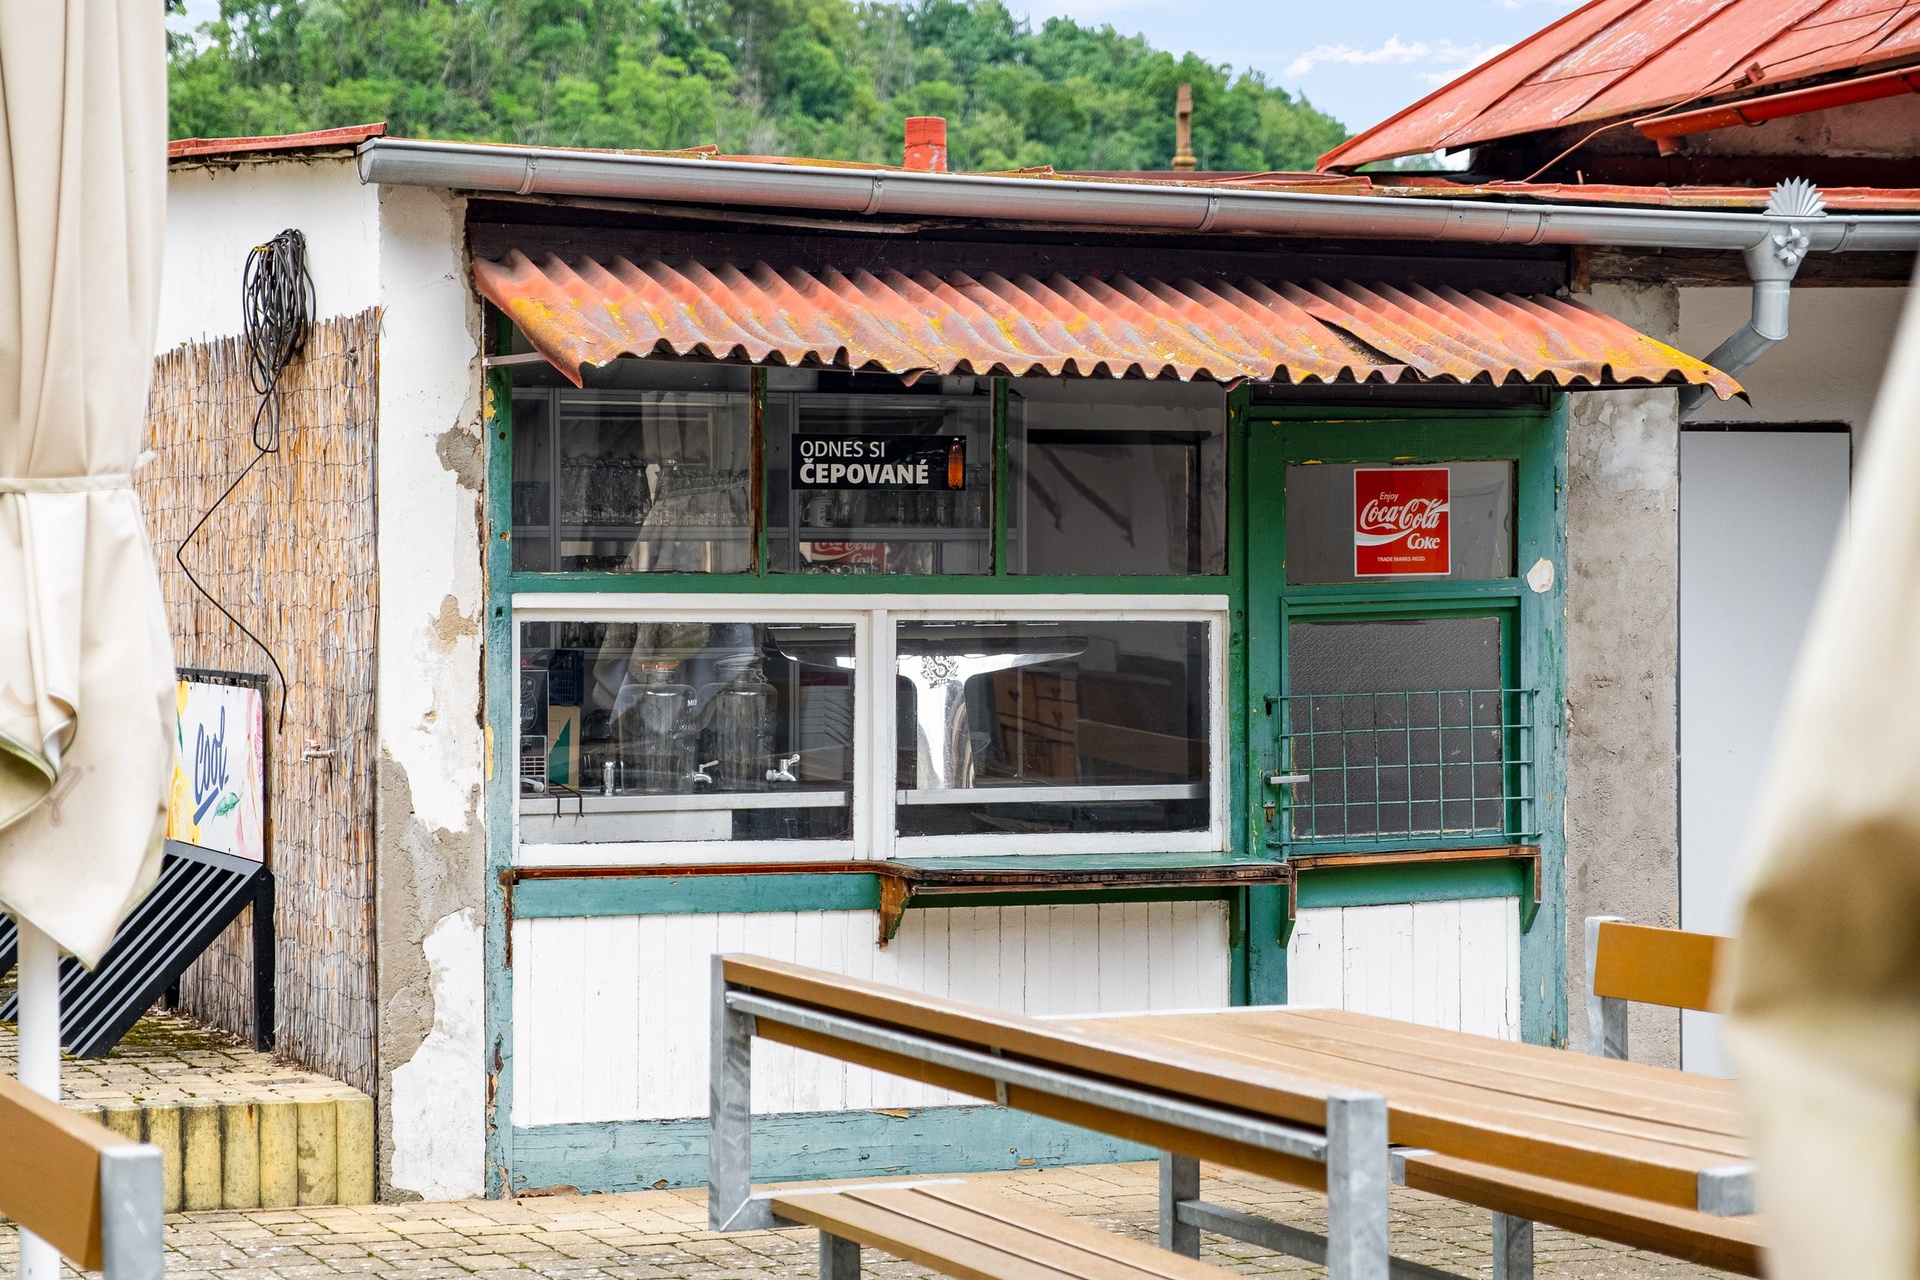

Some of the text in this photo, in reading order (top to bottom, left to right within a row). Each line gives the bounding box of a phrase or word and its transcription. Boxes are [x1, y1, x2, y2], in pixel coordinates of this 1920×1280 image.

[800, 440, 885, 458] ODNES SI
[799, 457, 929, 485] ČEPOVANÉ
[1379, 491, 1399, 503] Enjoy
[1360, 498, 1443, 530] Coca-Cola
[1407, 532, 1441, 550] Coke
